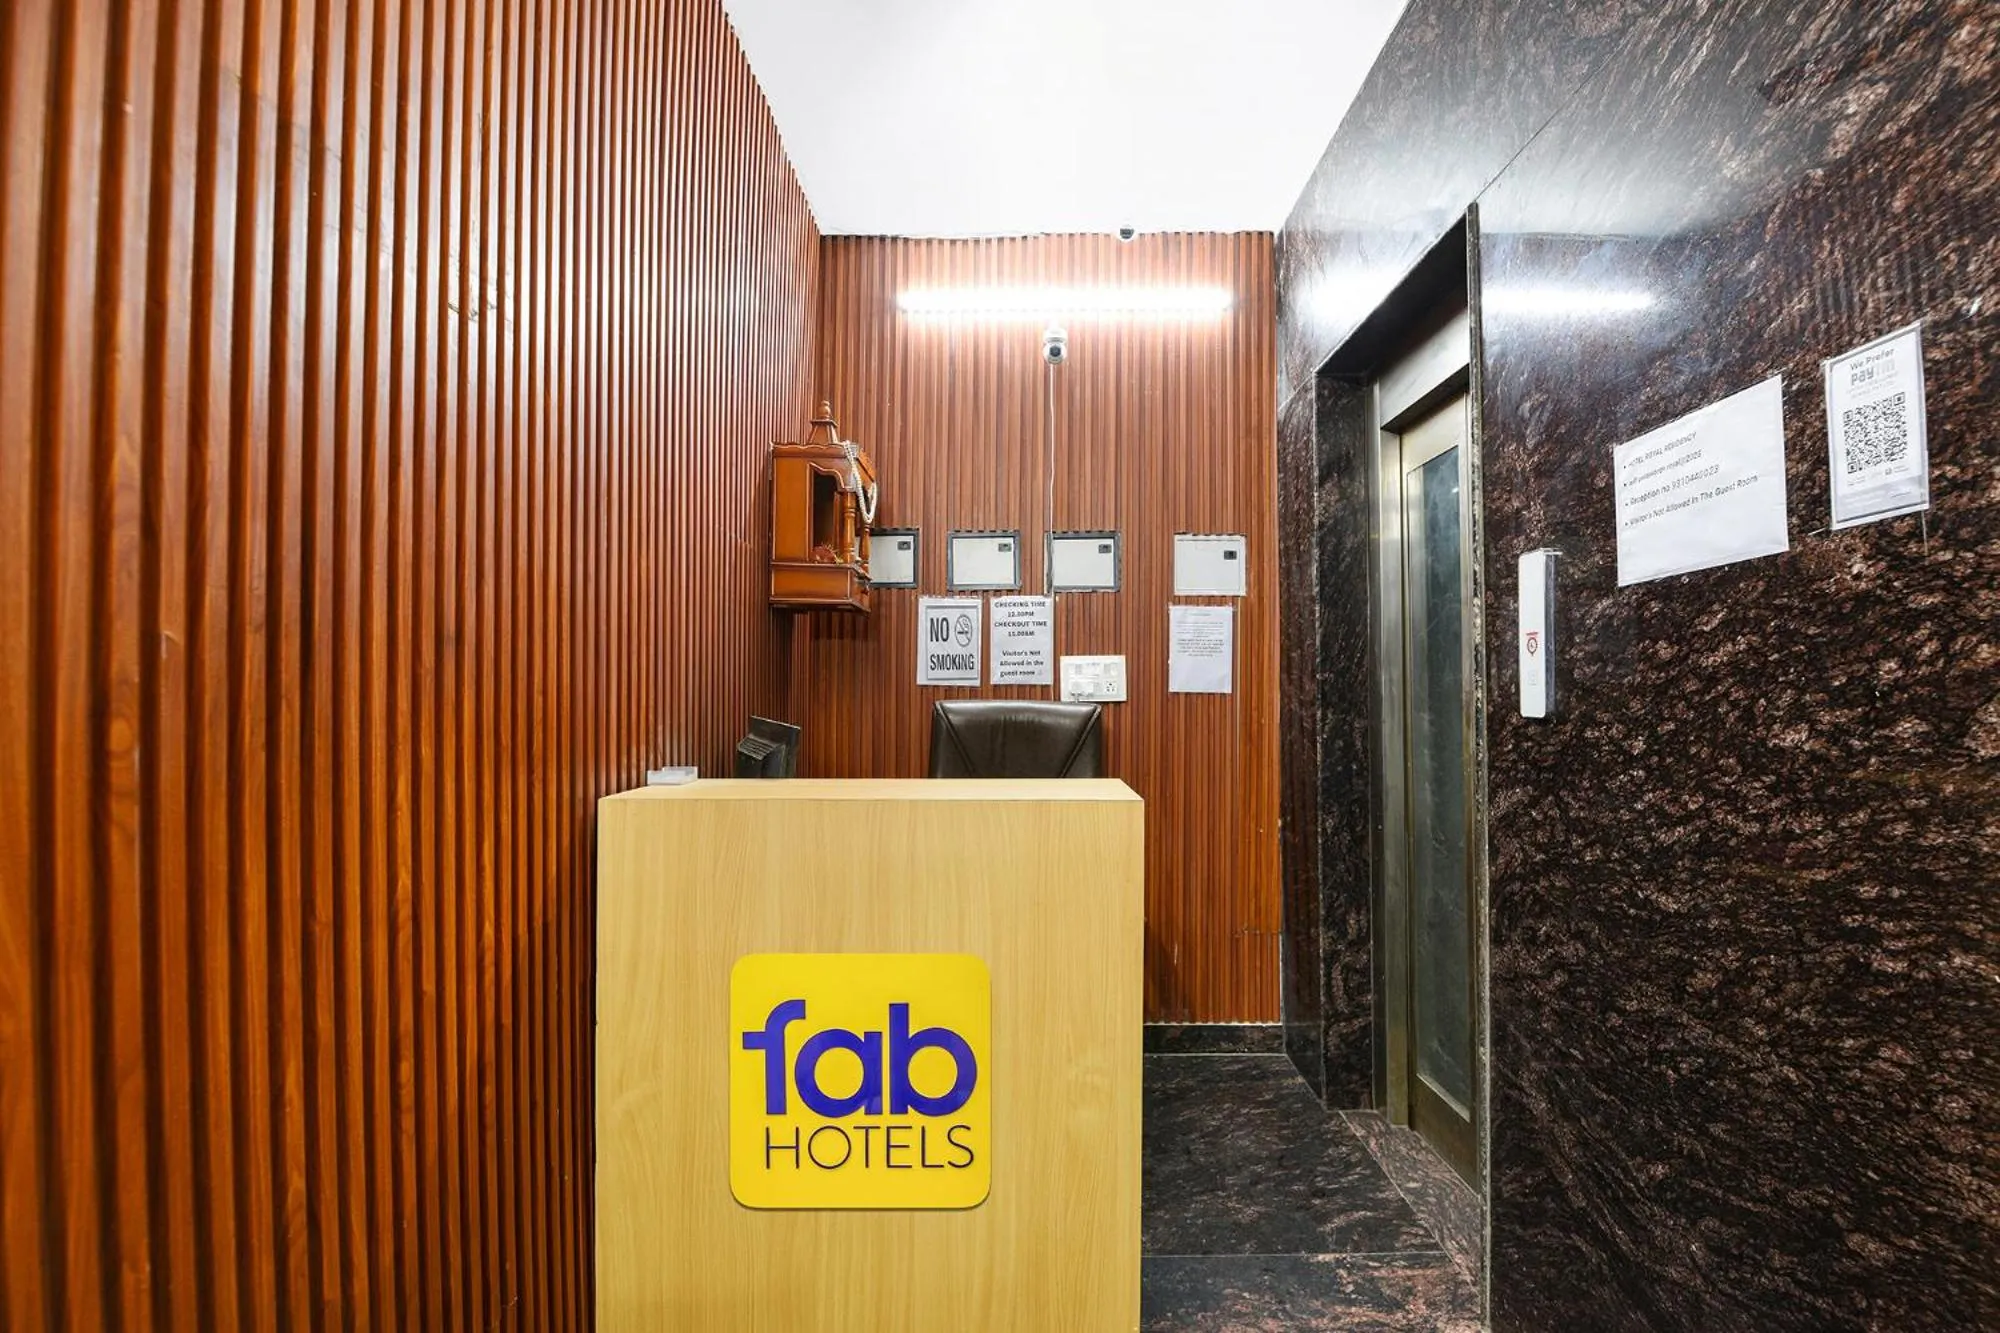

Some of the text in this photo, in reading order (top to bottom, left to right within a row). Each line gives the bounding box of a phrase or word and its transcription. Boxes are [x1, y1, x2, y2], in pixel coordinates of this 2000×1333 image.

[1630, 488, 1660, 505] Reception
[1700, 491, 1714, 501] The
[929, 617, 949, 643] NO
[929, 653, 975, 671] SMOKING
[742, 998, 978, 1118] fab
[765, 1124, 975, 1170] HOTELS
